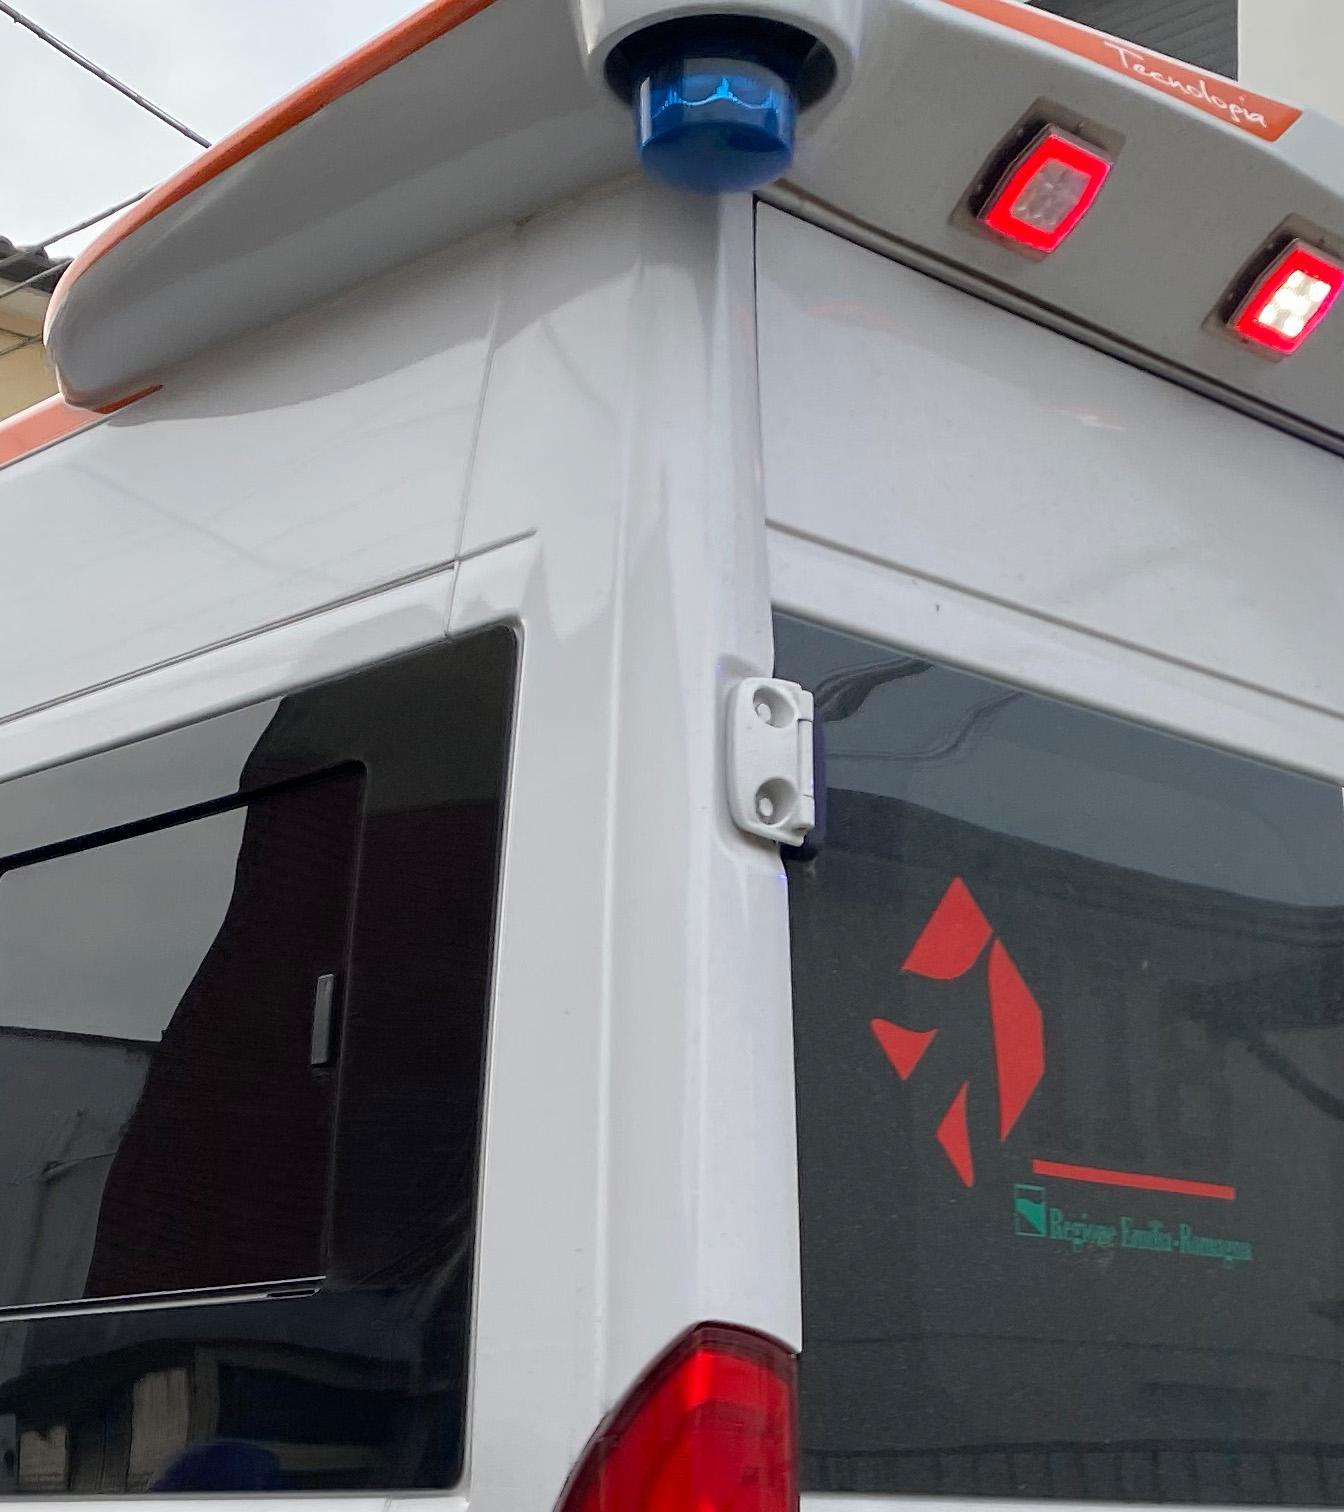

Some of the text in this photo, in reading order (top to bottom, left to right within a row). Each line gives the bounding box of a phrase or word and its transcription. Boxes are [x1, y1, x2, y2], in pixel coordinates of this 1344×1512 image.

[1103, 40, 1268, 129] Tecnologia
[1050, 1207, 1253, 1269] Regione Emilia-Romagna
